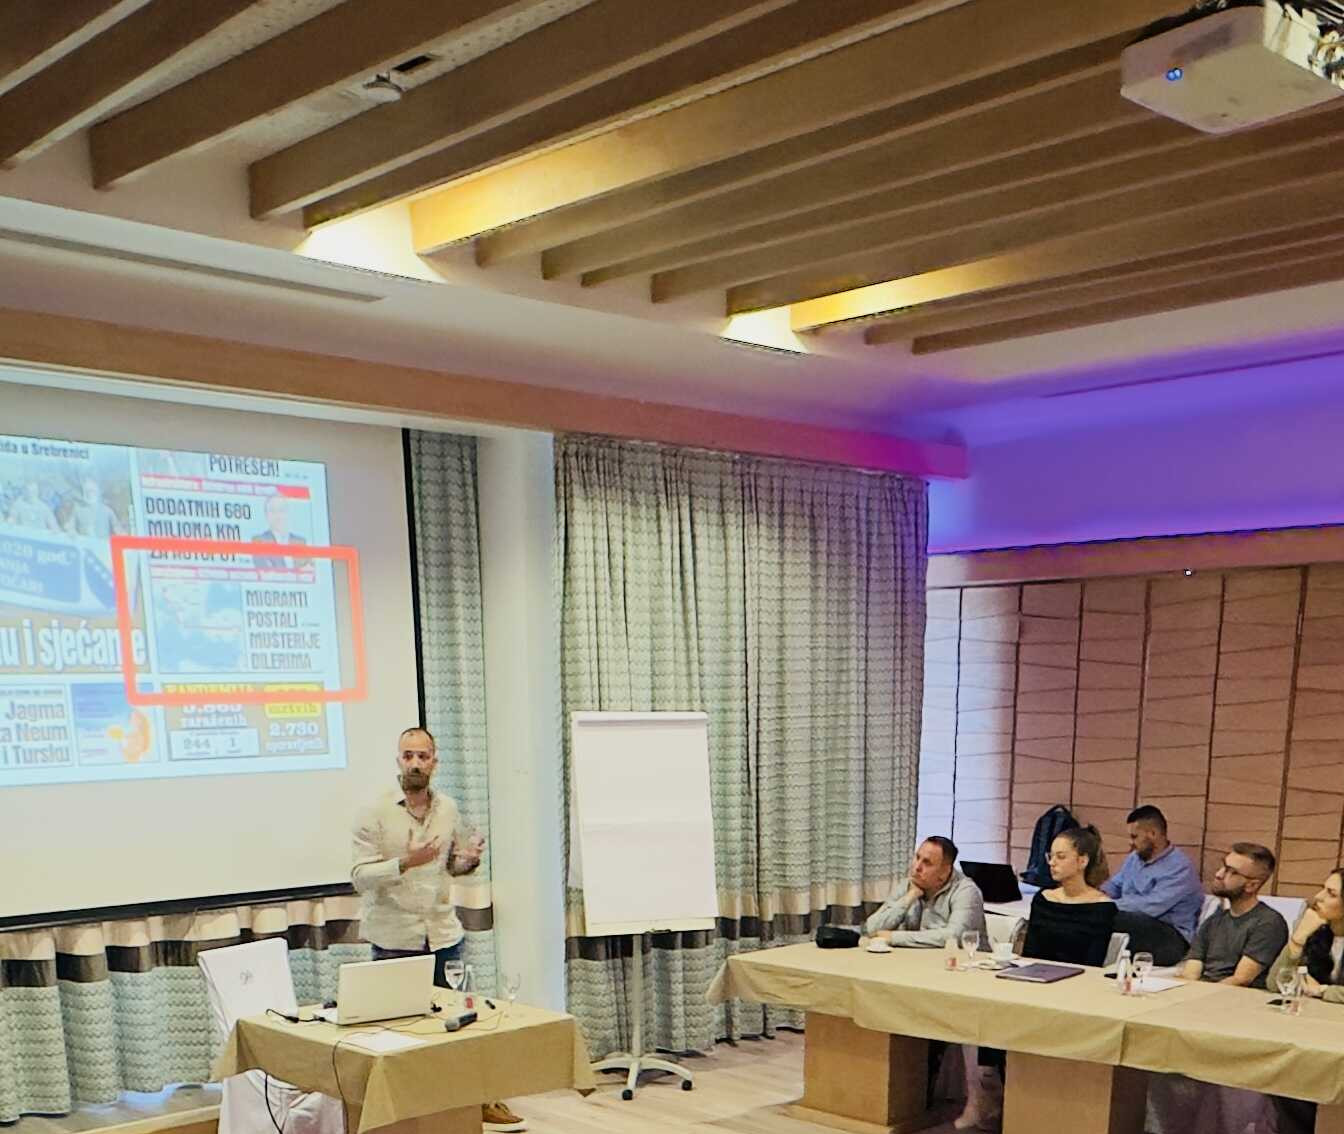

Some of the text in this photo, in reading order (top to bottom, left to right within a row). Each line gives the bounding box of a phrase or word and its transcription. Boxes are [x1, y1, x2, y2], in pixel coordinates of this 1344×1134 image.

[22, 446, 29, 454] u
[31, 443, 90, 459] Srebrenici
[146, 497, 221, 518] DODATNIH
[148, 520, 241, 541] MILIONA KM
[246, 590, 309, 608] MIGRANTI
[248, 611, 298, 628] POSTALI
[22, 619, 35, 667] i
[38, 620, 148, 671] sjećane
[251, 652, 312, 670] DILERIMA
[5, 700, 65, 722] Jagma
[16, 722, 68, 742] Neum
[2, 743, 71, 765] i Tursku
